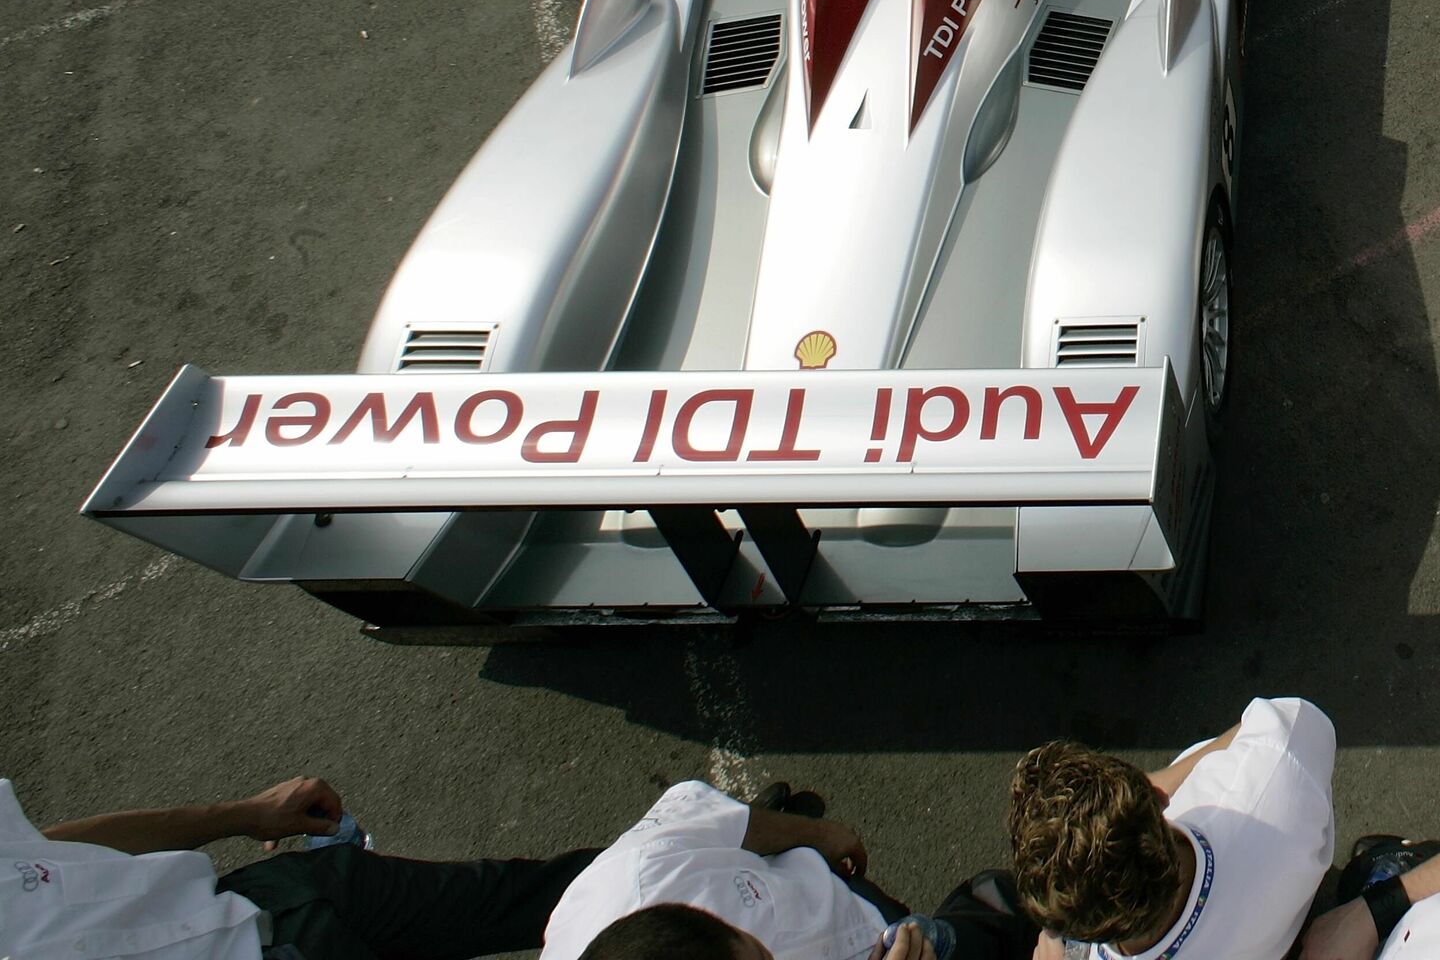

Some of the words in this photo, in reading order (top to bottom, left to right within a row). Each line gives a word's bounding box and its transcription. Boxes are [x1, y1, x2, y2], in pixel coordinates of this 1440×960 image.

[923, 16, 960, 59] TDI
[205, 390, 600, 462] Power
[636, 389, 820, 462] TDI
[866, 386, 1137, 462] Audi
[1203, 848, 1213, 888] ITALIA
